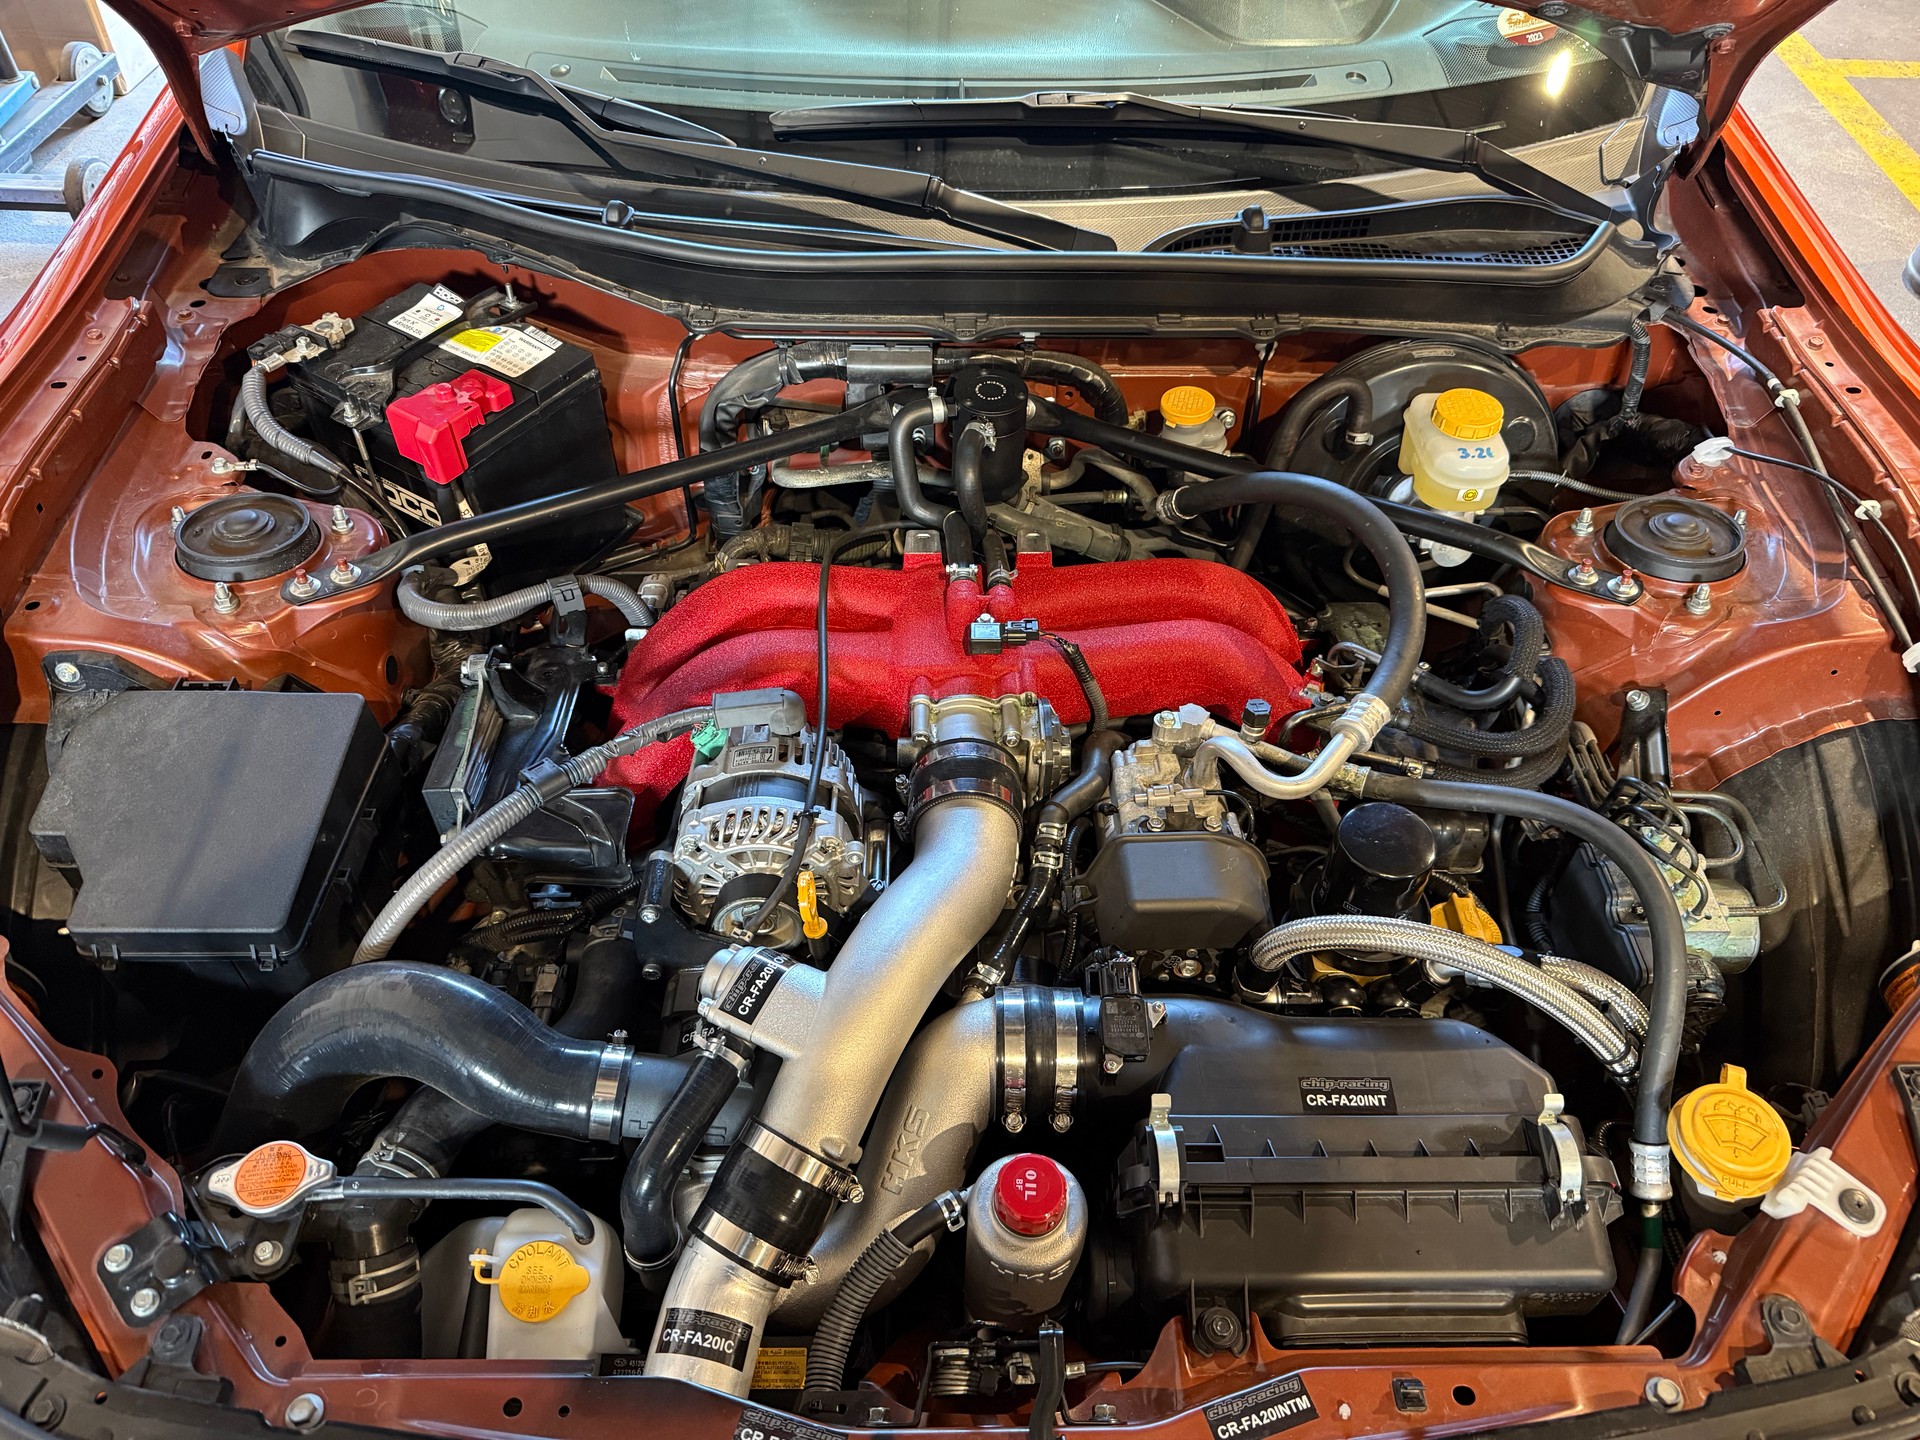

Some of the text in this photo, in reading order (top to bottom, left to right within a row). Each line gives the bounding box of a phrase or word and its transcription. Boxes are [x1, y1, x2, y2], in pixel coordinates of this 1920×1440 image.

[1525, 31, 1544, 43] 2023
[518, 336, 543, 352] WARRANTY
[1301, 1078, 1390, 1091] chip-racing
[1306, 1094, 1387, 1106] CR-FA20INT
[880, 1104, 930, 1195] HKS
[1015, 1178, 1024, 1191] BF
[1025, 1169, 1037, 1201] OIL
[1722, 1174, 1750, 1190] PULL
[508, 1242, 571, 1270] COOLANT
[526, 1265, 544, 1275] SEE
[666, 1308, 751, 1341] chip-racing
[662, 1328, 734, 1354] CR-FA20IC
[1207, 1377, 1301, 1421] chip-racing
[1217, 1394, 1312, 1439] CR-FA20INTM
